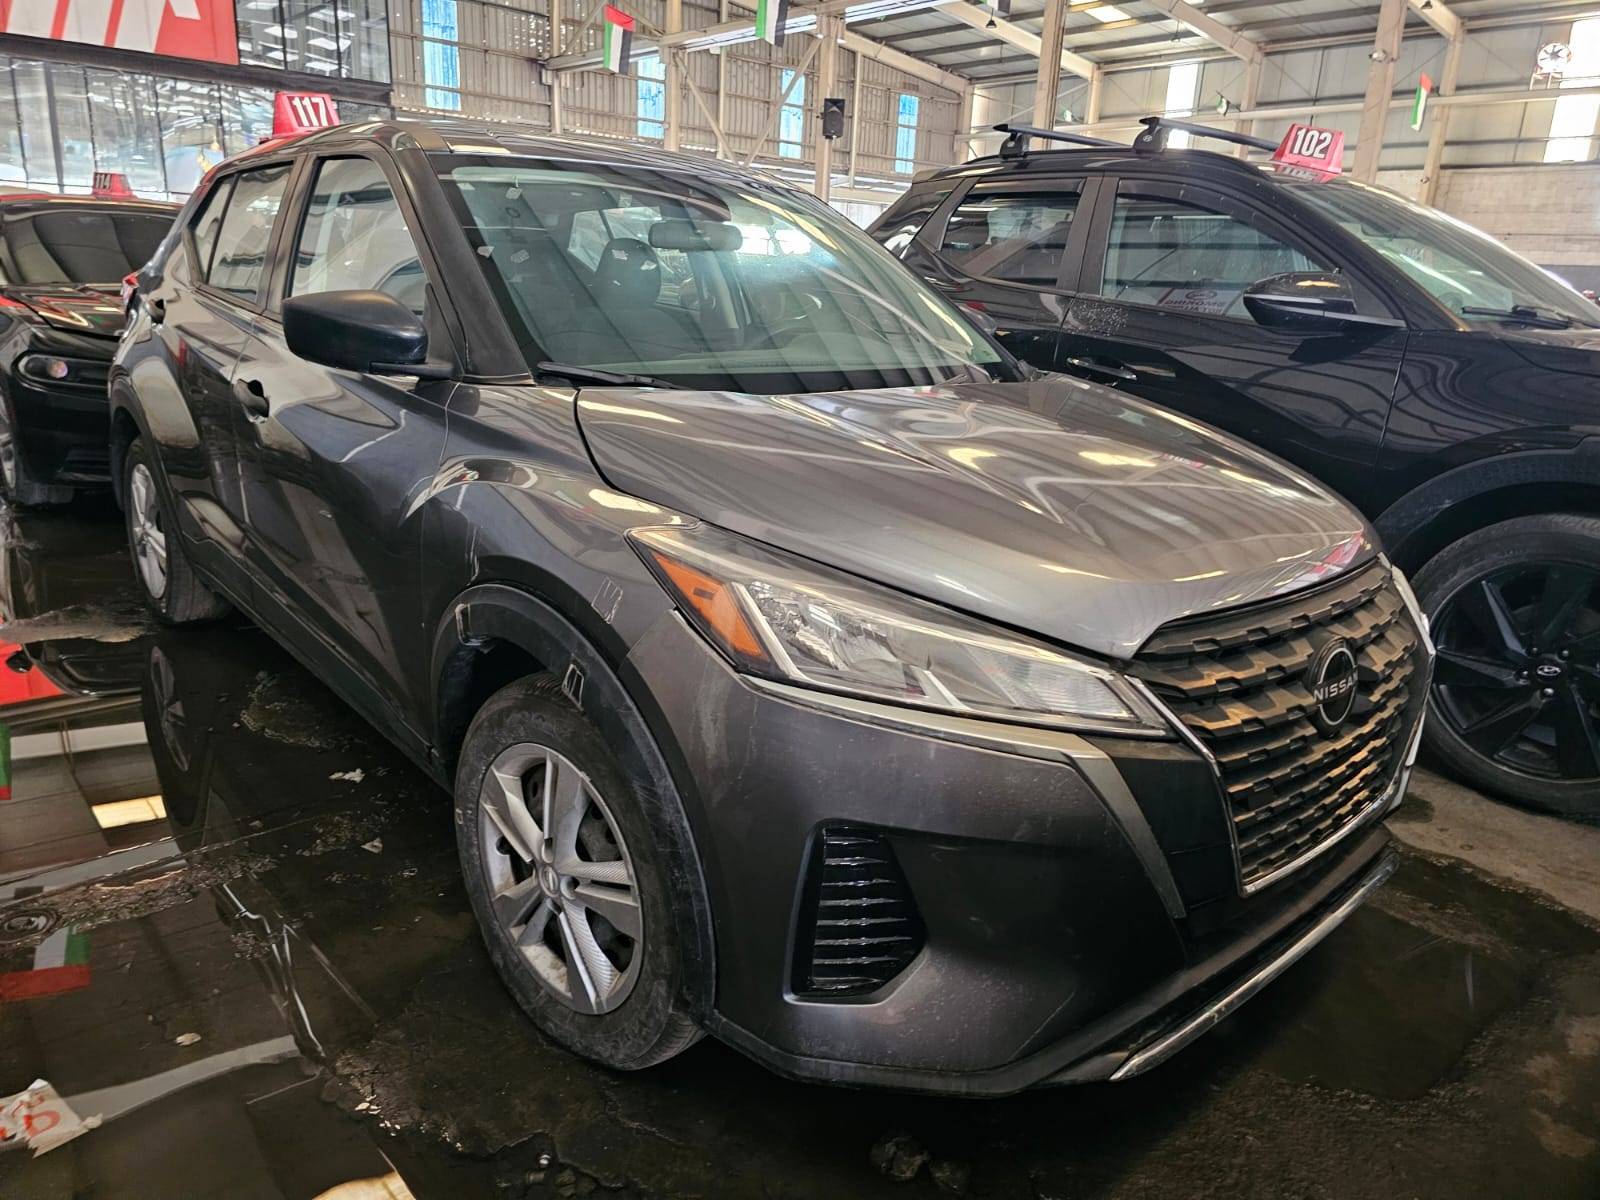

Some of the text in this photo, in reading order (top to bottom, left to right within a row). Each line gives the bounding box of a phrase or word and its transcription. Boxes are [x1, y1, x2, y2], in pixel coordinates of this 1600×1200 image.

[291, 96, 329, 127] 117
[1293, 128, 1333, 159] 102
[1313, 670, 1359, 702] NISSAN
